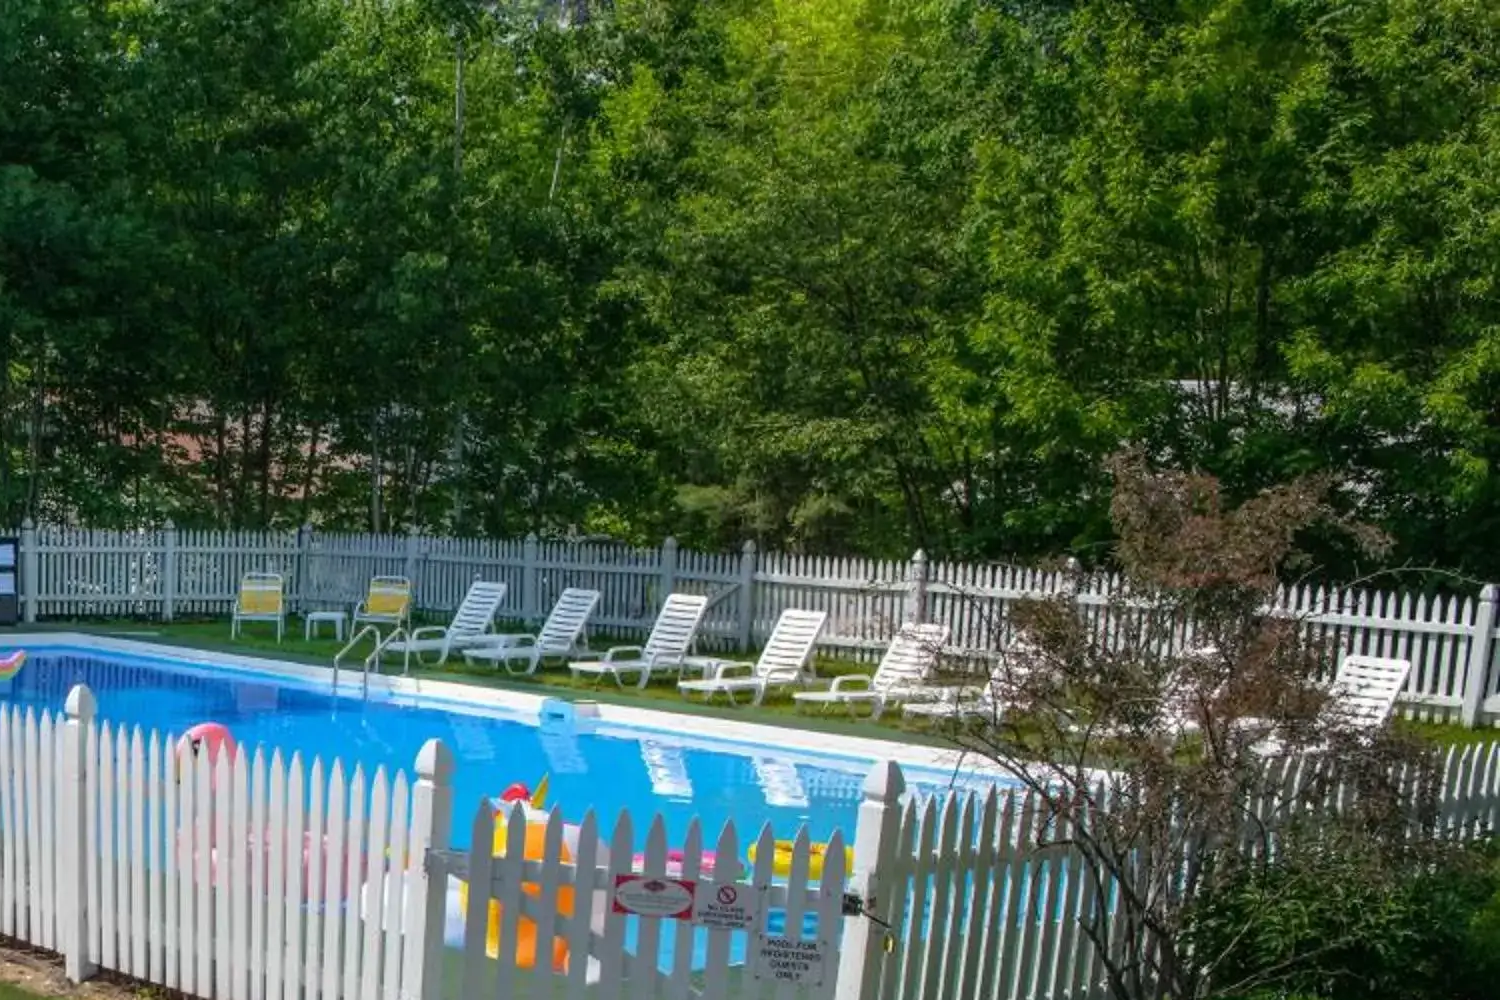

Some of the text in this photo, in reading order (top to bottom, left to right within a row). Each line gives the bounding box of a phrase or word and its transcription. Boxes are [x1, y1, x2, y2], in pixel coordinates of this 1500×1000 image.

[767, 939, 817, 951] POOL FOR
[760, 949, 821, 961] REGISTERED
[769, 961, 809, 971] GUESTS
[775, 971, 800, 980] ONLY
